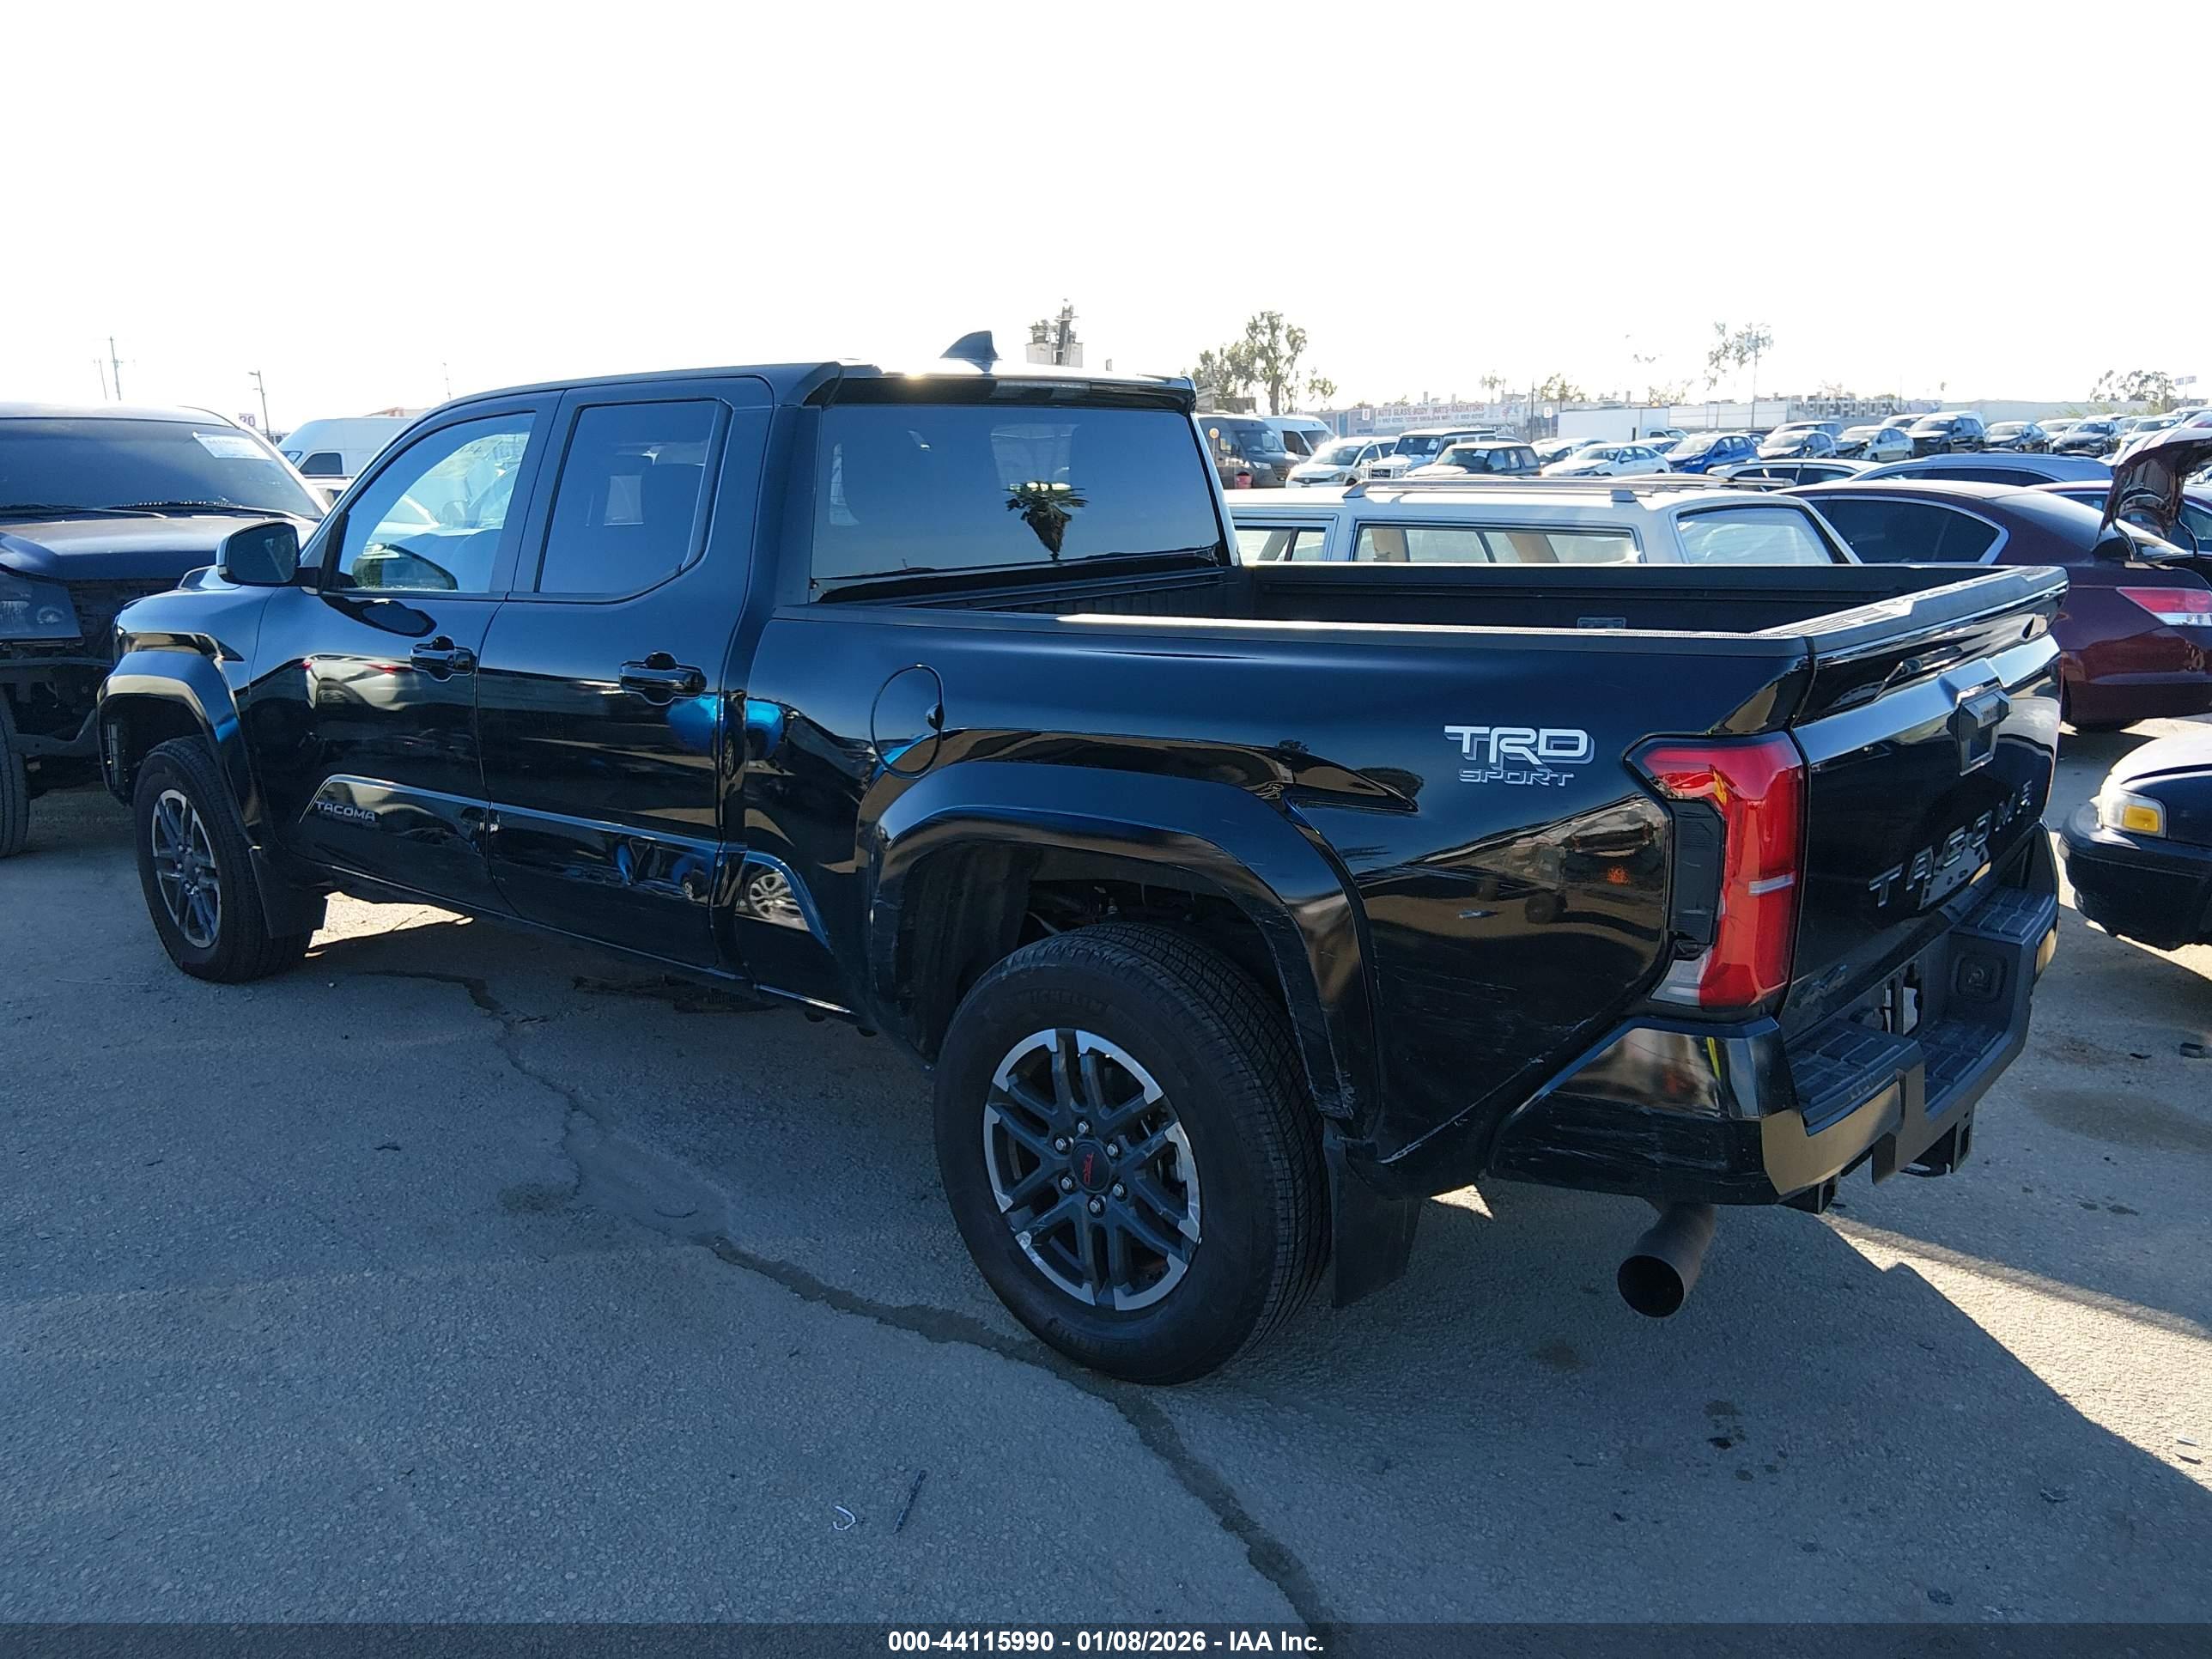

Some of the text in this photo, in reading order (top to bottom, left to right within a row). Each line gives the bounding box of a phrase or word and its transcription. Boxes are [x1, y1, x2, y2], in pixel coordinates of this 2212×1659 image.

[1443, 725, 1595, 771] TRD
[1459, 769, 1575, 787] SPORT
[315, 800, 376, 822] TACOMA
